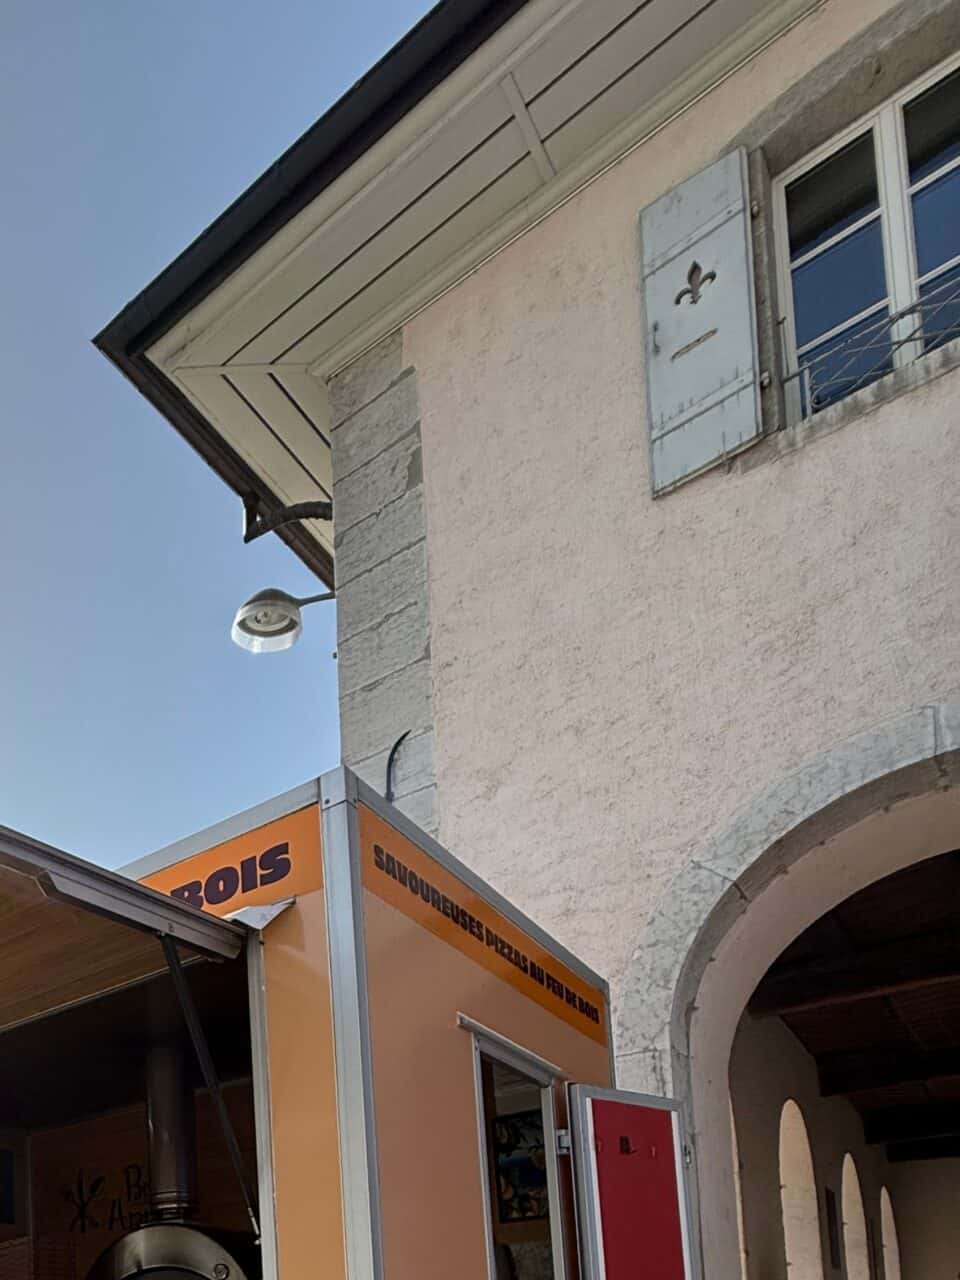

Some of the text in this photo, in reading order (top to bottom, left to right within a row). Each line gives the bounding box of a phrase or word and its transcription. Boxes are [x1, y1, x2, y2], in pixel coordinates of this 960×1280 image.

[170, 842, 292, 910] BOIS
[374, 844, 484, 942] SAVOUREUSES
[484, 926, 529, 975] PIZZAS
[577, 996, 600, 1024] BOIS
